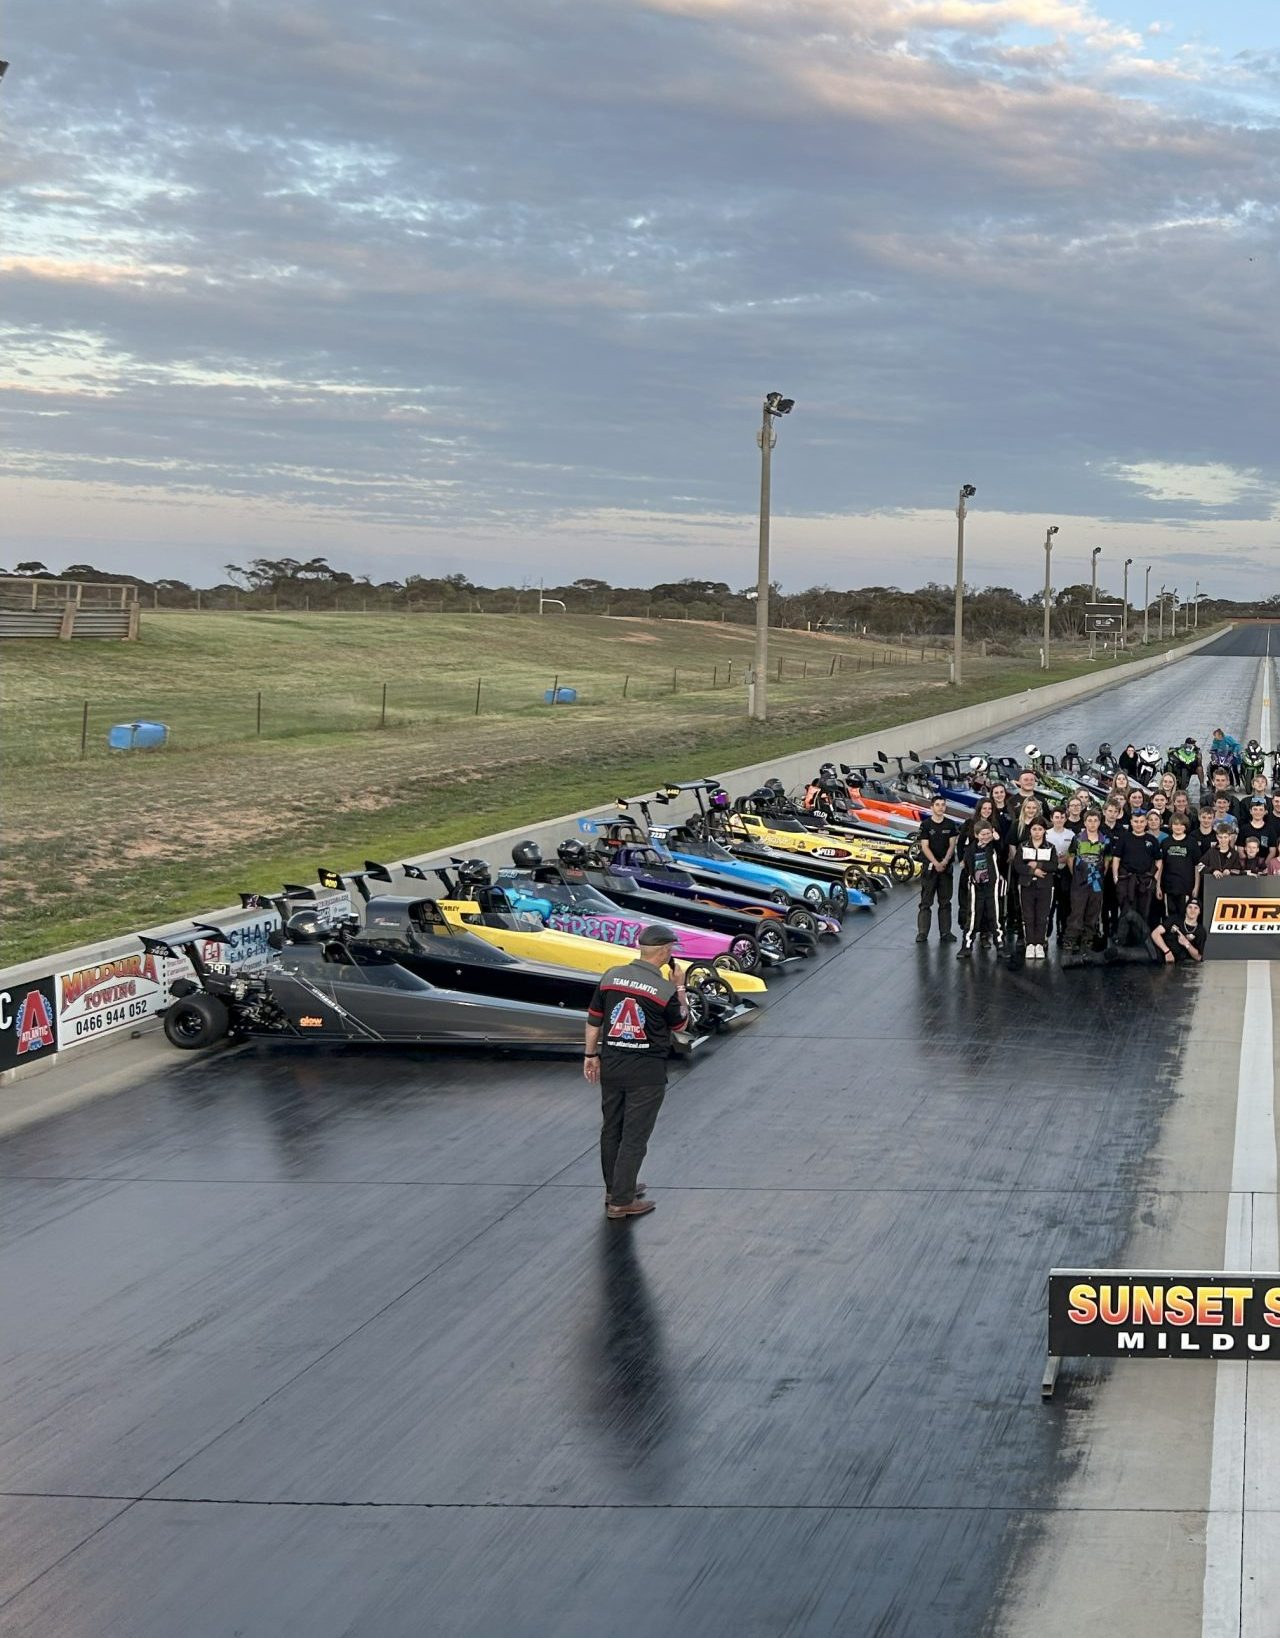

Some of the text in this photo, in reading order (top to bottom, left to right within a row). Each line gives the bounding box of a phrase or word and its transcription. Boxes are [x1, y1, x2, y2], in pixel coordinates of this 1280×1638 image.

[1217, 923, 1248, 931] GOLF
[60, 954, 160, 1016] MILDURA
[83, 980, 138, 1012] TOWING
[612, 977, 659, 996] TEAM ATLANTIC
[76, 1000, 148, 1036] 0466 944 052
[614, 1022, 641, 1034] ATANTIC
[22, 1024, 49, 1042] ATLANTIC
[1067, 1284, 1254, 1327] SUNSET
